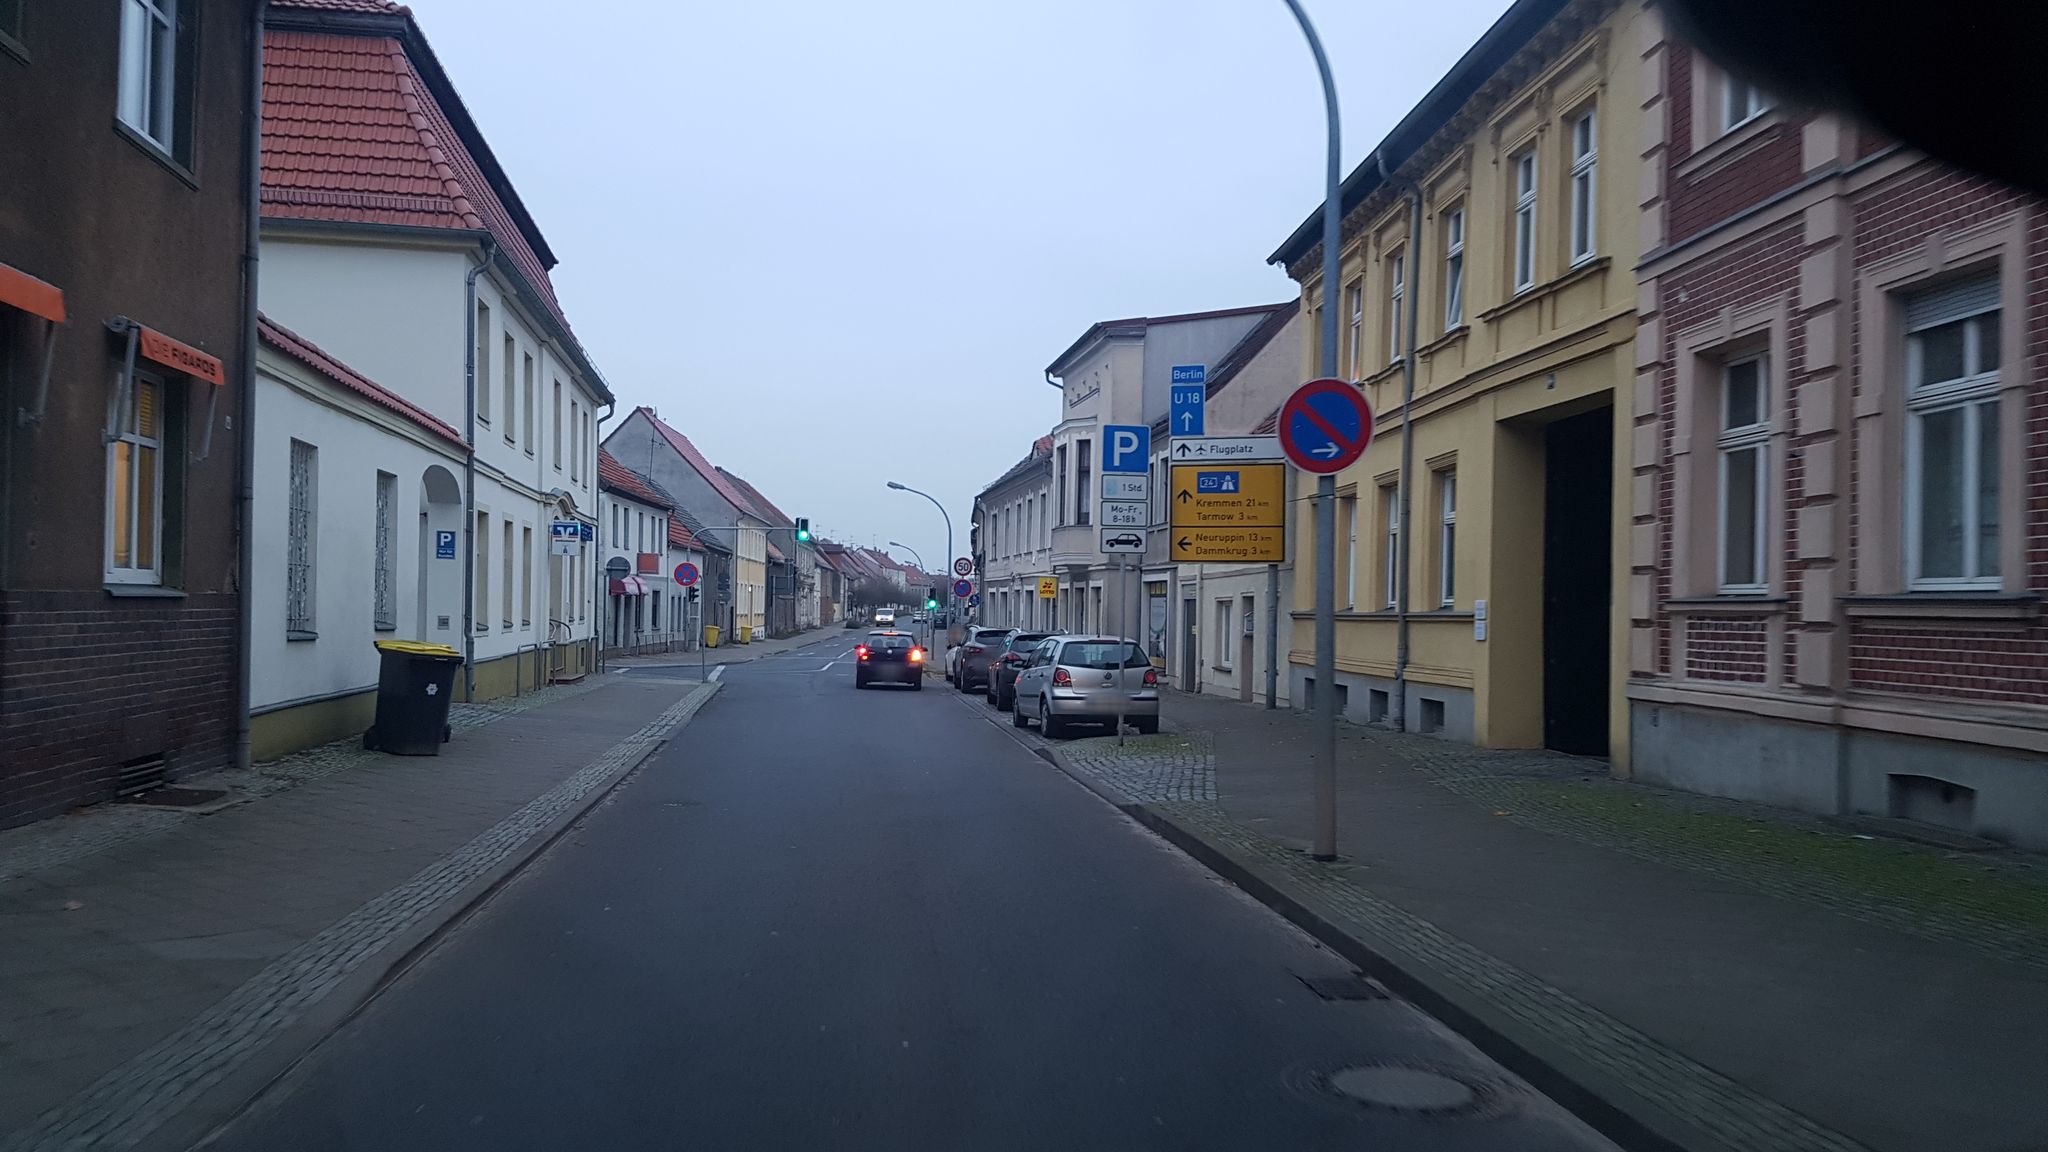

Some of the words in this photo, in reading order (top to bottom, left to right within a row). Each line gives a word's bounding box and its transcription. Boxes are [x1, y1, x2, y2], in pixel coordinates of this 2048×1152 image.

[172, 347, 216, 376] FIGAROS
[1173, 370, 1203, 380] Berlin
[1174, 393, 1183, 404] U
[1188, 393, 1200, 403] 18
[1113, 431, 1139, 466] P
[1210, 445, 1253, 456] Flugplatz
[1122, 483, 1126, 491] 1
[1203, 479, 1214, 487] 24
[1196, 499, 1242, 507] Kremmen
[1246, 499, 1256, 507] 21
[1197, 512, 1234, 520] Tarmow
[1239, 512, 1245, 520] 3
[440, 533, 452, 546] P
[1196, 533, 1245, 543] Neuruppin
[1249, 533, 1258, 541] 13
[1196, 546, 1248, 557] Dammkrug
[1251, 546, 1257, 555] 3
[958, 563, 969, 572] 50
